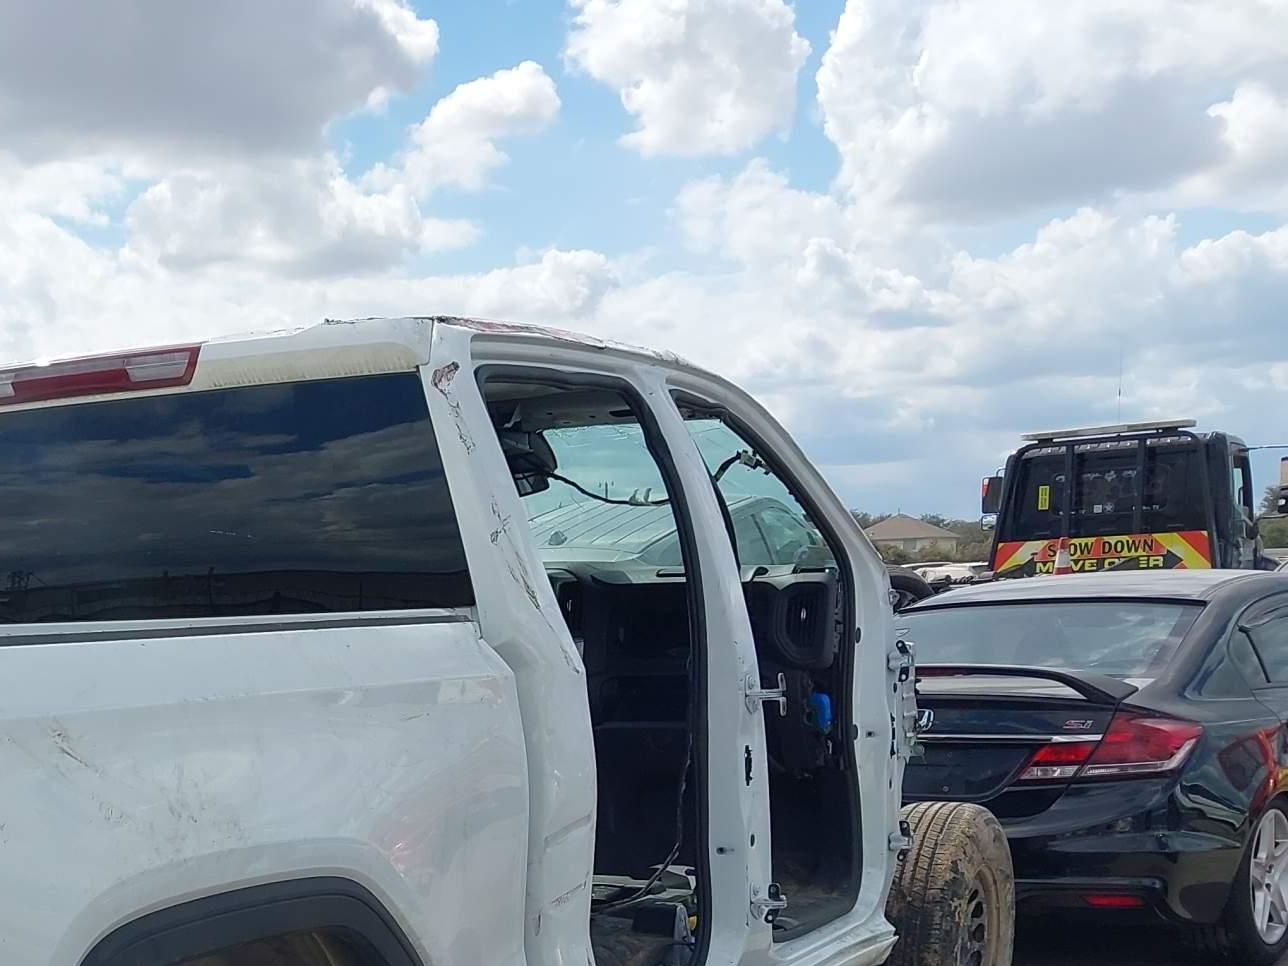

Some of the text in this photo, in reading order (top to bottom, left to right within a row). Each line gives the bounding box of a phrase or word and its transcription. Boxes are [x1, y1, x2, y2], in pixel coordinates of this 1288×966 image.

[1047, 538, 1154, 558] SOW DOWN
[1035, 556, 1164, 573] MVE OER
